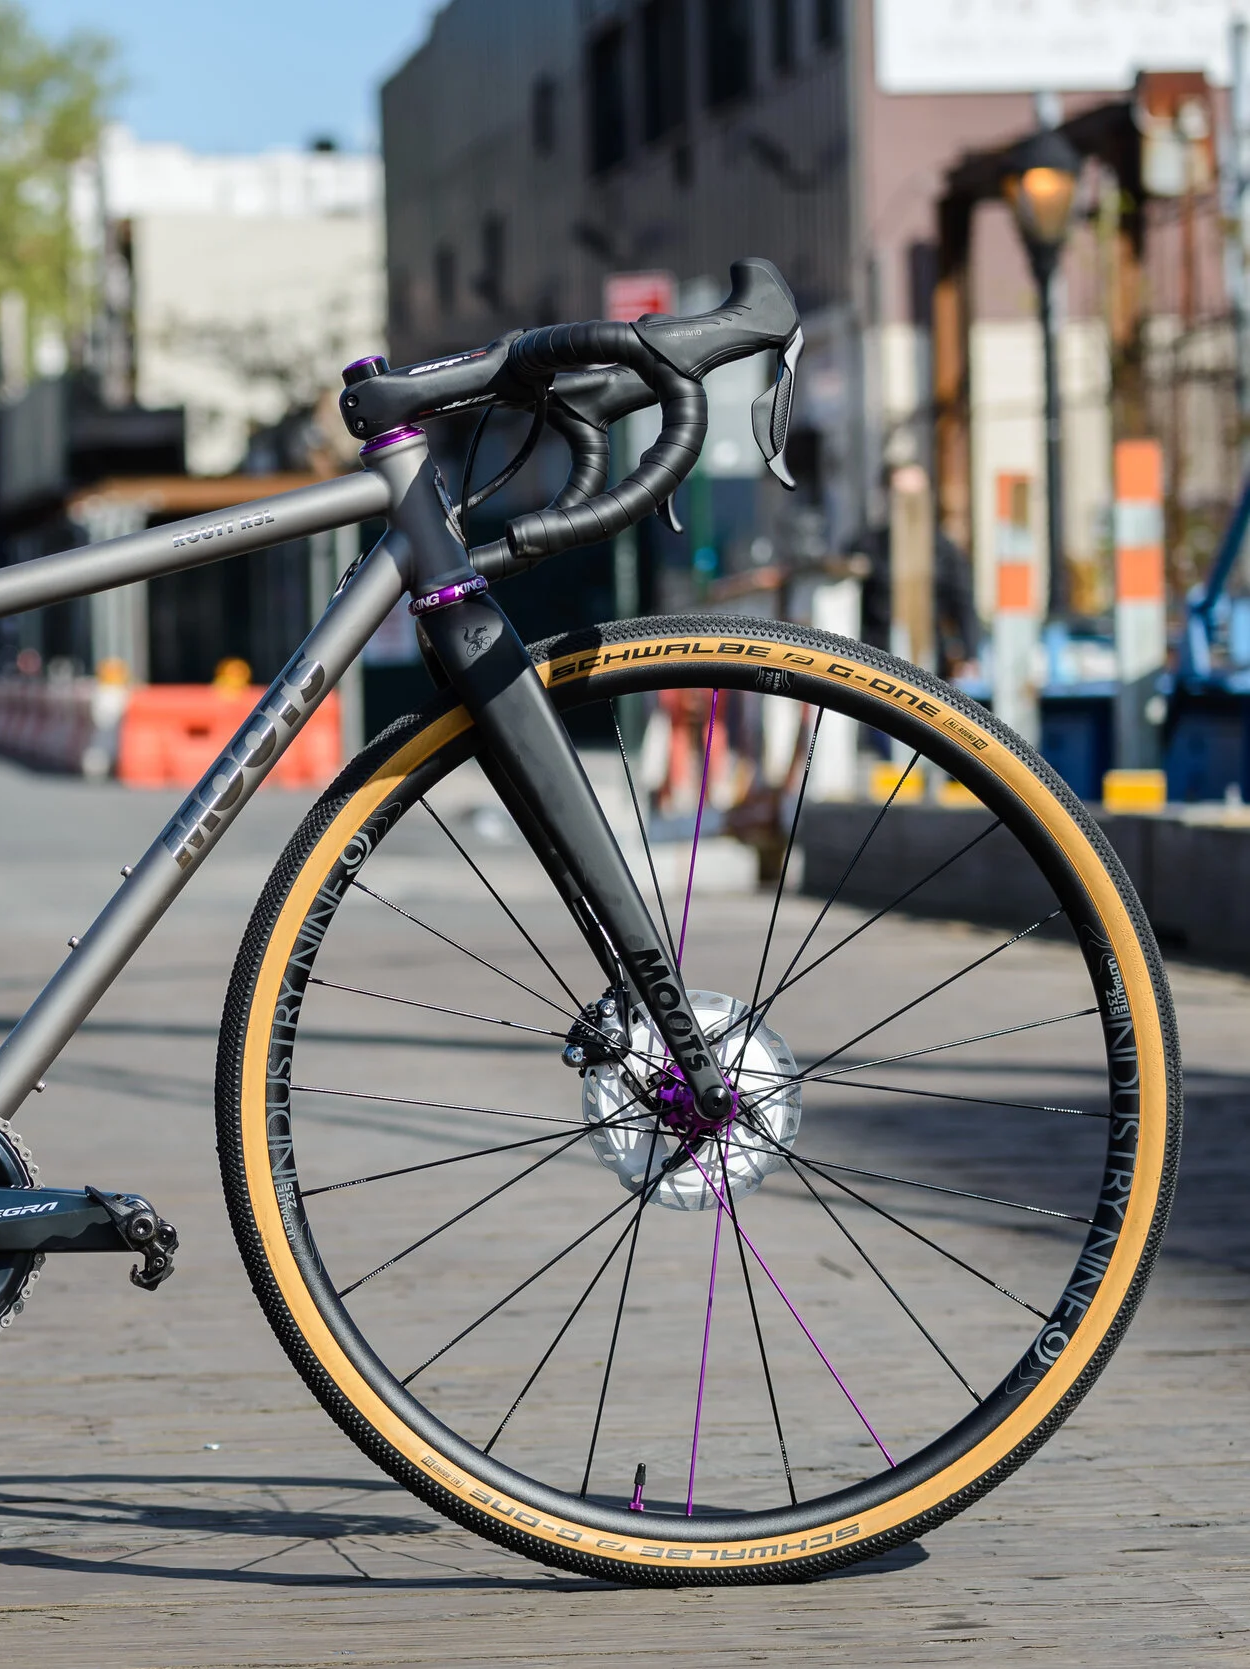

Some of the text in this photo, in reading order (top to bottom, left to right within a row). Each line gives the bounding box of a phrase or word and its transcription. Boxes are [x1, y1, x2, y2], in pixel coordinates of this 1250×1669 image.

[172, 509, 275, 548] ROUTT RSL
[412, 593, 440, 612] KING
[453, 578, 482, 597] KING
[552, 642, 941, 718] SCHWALBE G-ONE
[161, 651, 326, 872] MOOTS
[631, 948, 710, 1072] MOOTS
[1105, 990, 1121, 1016] 235
[1107, 957, 1130, 1014] ULTRALITE
[266, 976, 303, 1185] INDUSTRY
[1100, 1014, 1140, 1221] INDUSTRY
[275, 1184, 295, 1245] ULTRALITE
[287, 1182, 297, 1209] 235
[468, 1488, 860, 1561] SCHWALBE G-ONE
